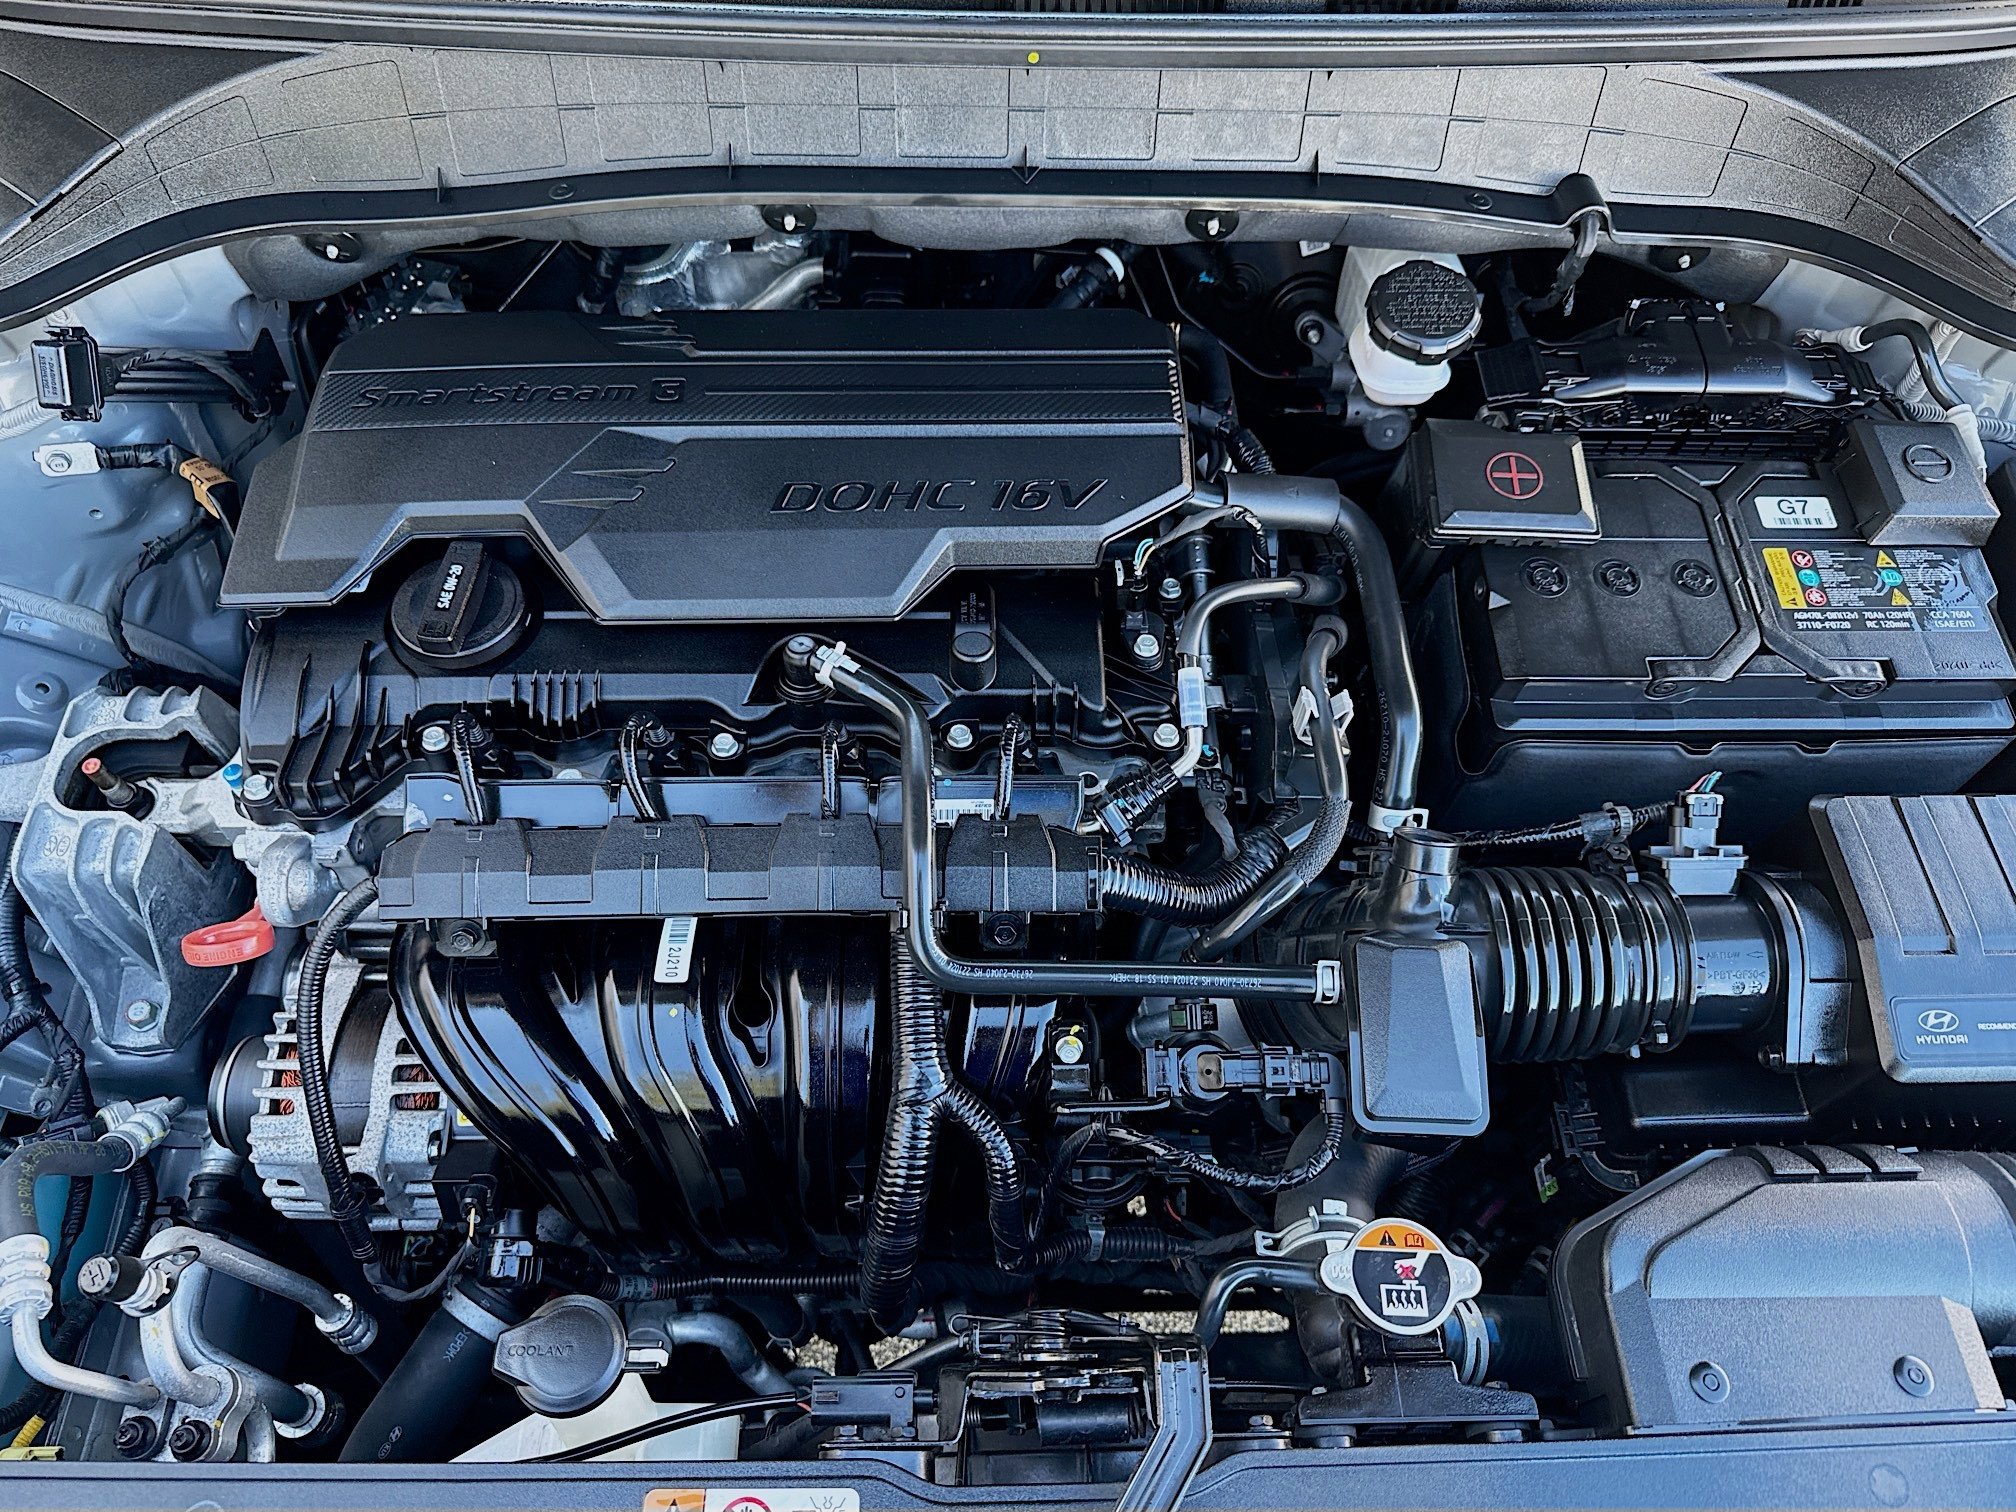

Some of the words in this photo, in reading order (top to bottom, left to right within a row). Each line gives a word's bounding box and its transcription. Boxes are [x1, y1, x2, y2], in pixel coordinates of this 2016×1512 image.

[350, 382, 638, 407] Smartstream
[770, 480, 976, 513] DOHC
[990, 479, 1109, 512] 16V
[1776, 499, 1808, 515] G7
[443, 564, 464, 592] 0W-20
[437, 591, 454, 609] SAE
[1862, 611, 1885, 619] 70Ah
[1886, 611, 1915, 620] (20HR)
[1931, 610, 1950, 619] CCA
[1950, 610, 1974, 619] 760A
[1796, 621, 1852, 630] 37110-F0720
[1880, 620, 1911, 628] 120min
[1378, 691, 1390, 763] 26710-2J070
[1378, 768, 1386, 782] HS
[204, 946, 244, 962] ENGINE
[664, 946, 682, 978] 2J210
[947, 961, 972, 977] 221024
[974, 968, 983, 978] HS
[986, 968, 1034, 979] 26730-2J040
[1173, 975, 1199, 986] 221024
[1201, 976, 1211, 986] HS
[1214, 976, 1262, 988] 26730-2J040
[1916, 1034, 1969, 1045] HYUNDAI
[443, 1327, 471, 1363] >EPDM<
[506, 1344, 575, 1358] COOLANT
